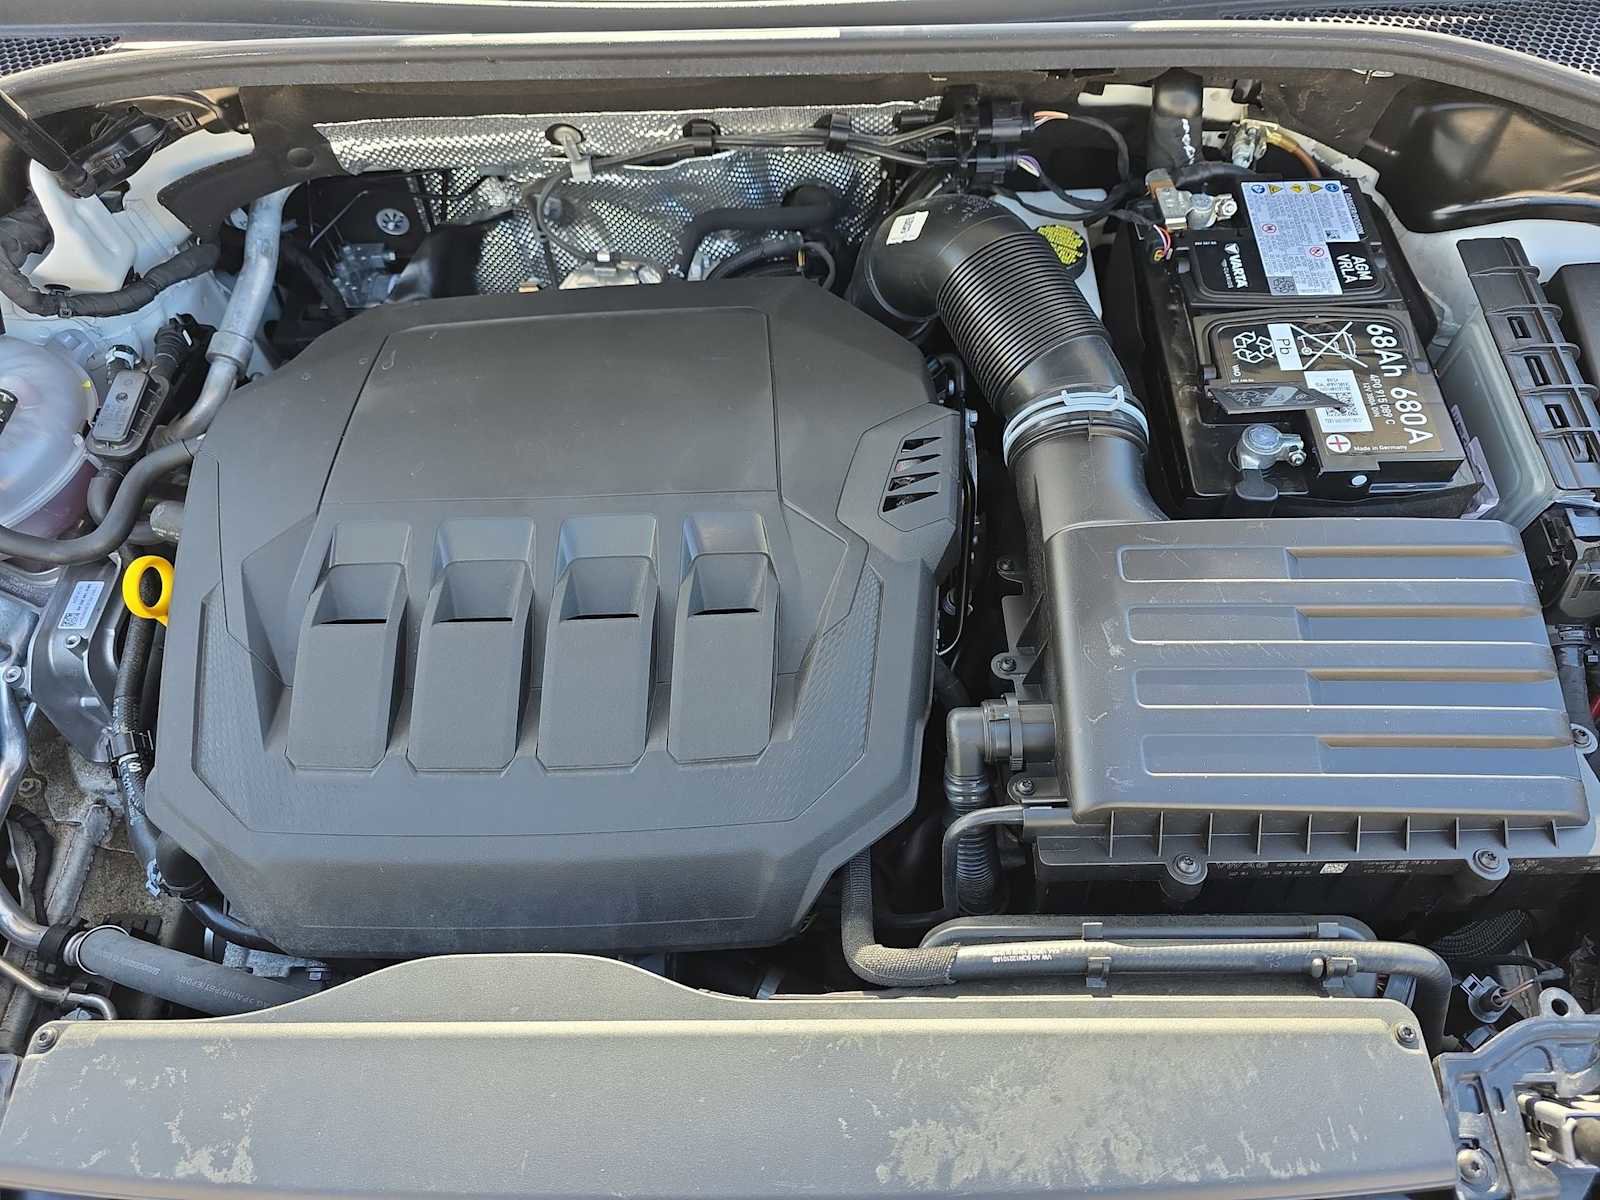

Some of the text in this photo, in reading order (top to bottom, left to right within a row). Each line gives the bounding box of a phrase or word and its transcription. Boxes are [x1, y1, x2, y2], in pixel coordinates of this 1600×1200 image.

[1229, 254, 1248, 288] VARTA
[1336, 253, 1358, 284] VRLA
[1351, 255, 1373, 280] AGM
[1276, 338, 1292, 355] Pb
[1366, 324, 1434, 444] 68Ah 680A
